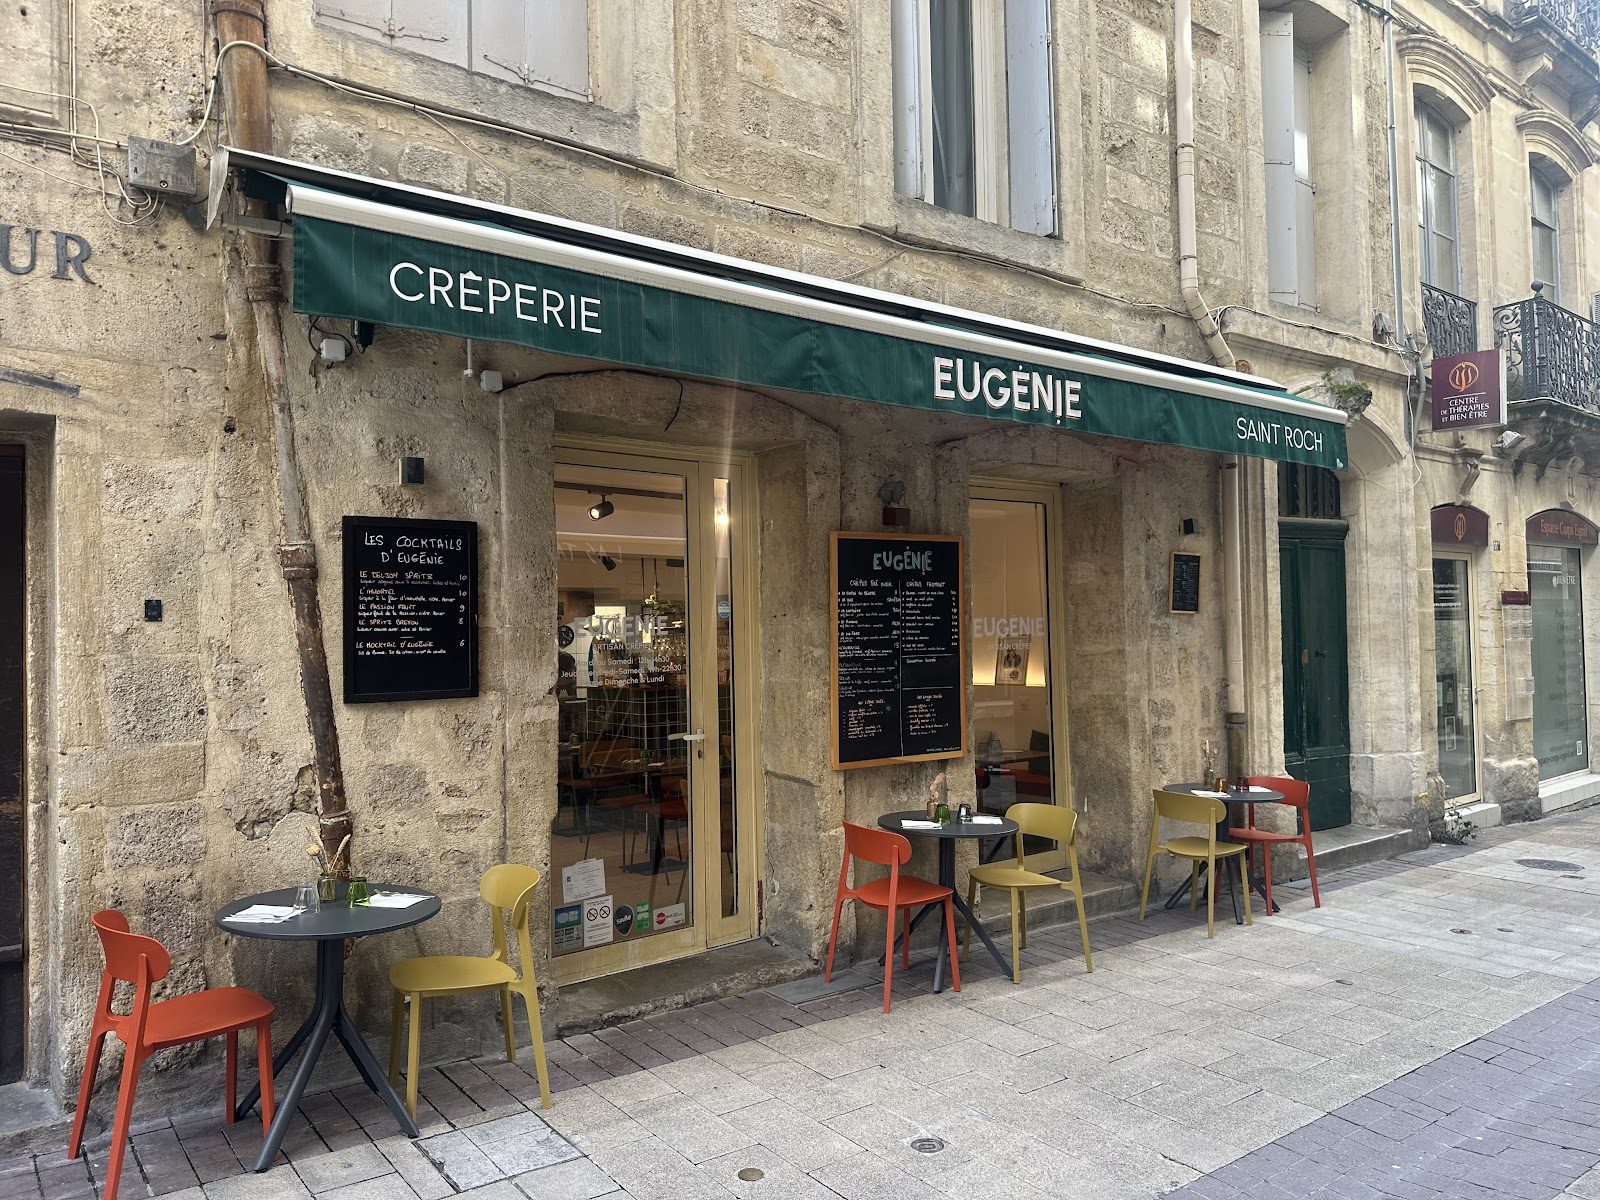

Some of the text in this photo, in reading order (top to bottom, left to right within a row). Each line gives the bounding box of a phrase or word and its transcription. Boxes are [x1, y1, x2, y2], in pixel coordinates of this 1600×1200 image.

[389, 262, 602, 334] CRÊPERIE
[934, 356, 1082, 424] EUGÉNIE
[1449, 396, 1479, 407] CENTRE
[1448, 403, 1490, 414] THÉRAPIES
[1449, 413, 1467, 421] BIEN
[1468, 410, 1488, 419] ÊTRE
[1237, 417, 1323, 452] SAINT ROCH
[1540, 518, 1558, 537] Espace
[364, 532, 462, 551] LES COCKTAILS
[592, 643, 624, 651] ARTISAN
[607, 658, 634, 666] Samedi
[605, 677, 639, 686] Dimanche
[647, 675, 665, 683] Lundi
